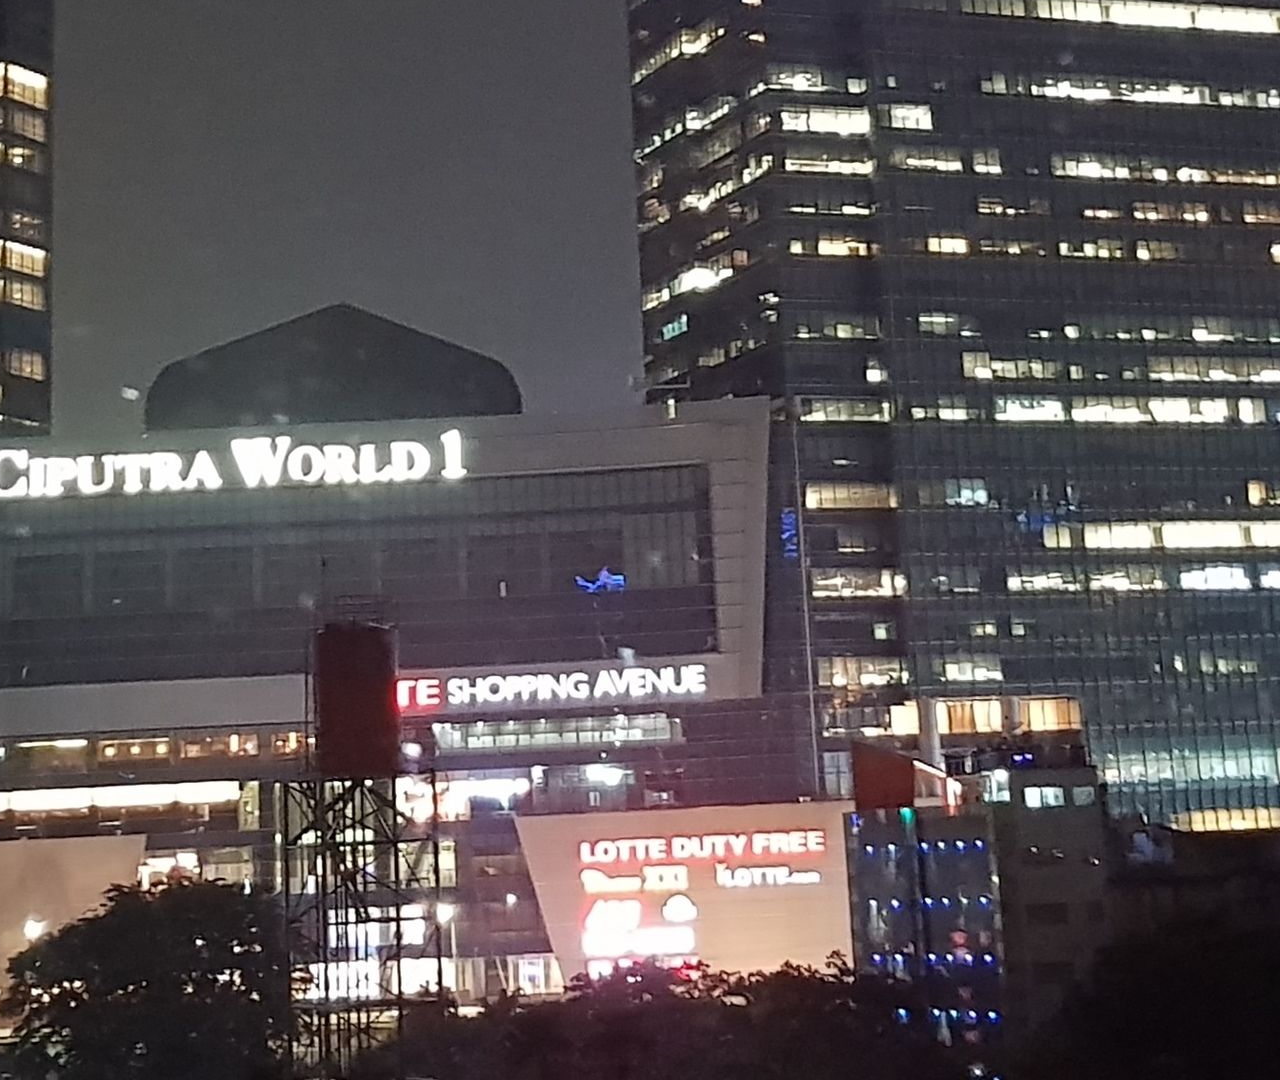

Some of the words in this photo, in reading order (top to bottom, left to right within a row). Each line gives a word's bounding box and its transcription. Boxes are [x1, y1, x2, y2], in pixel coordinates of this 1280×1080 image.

[230, 435, 431, 489] WORLD
[440, 429, 468, 481] 1
[447, 671, 591, 705] SHOPPING
[593, 664, 707, 698] AVENUE
[580, 837, 667, 863] LOTTE
[671, 833, 749, 859] DUTY
[752, 829, 826, 855] FREE
